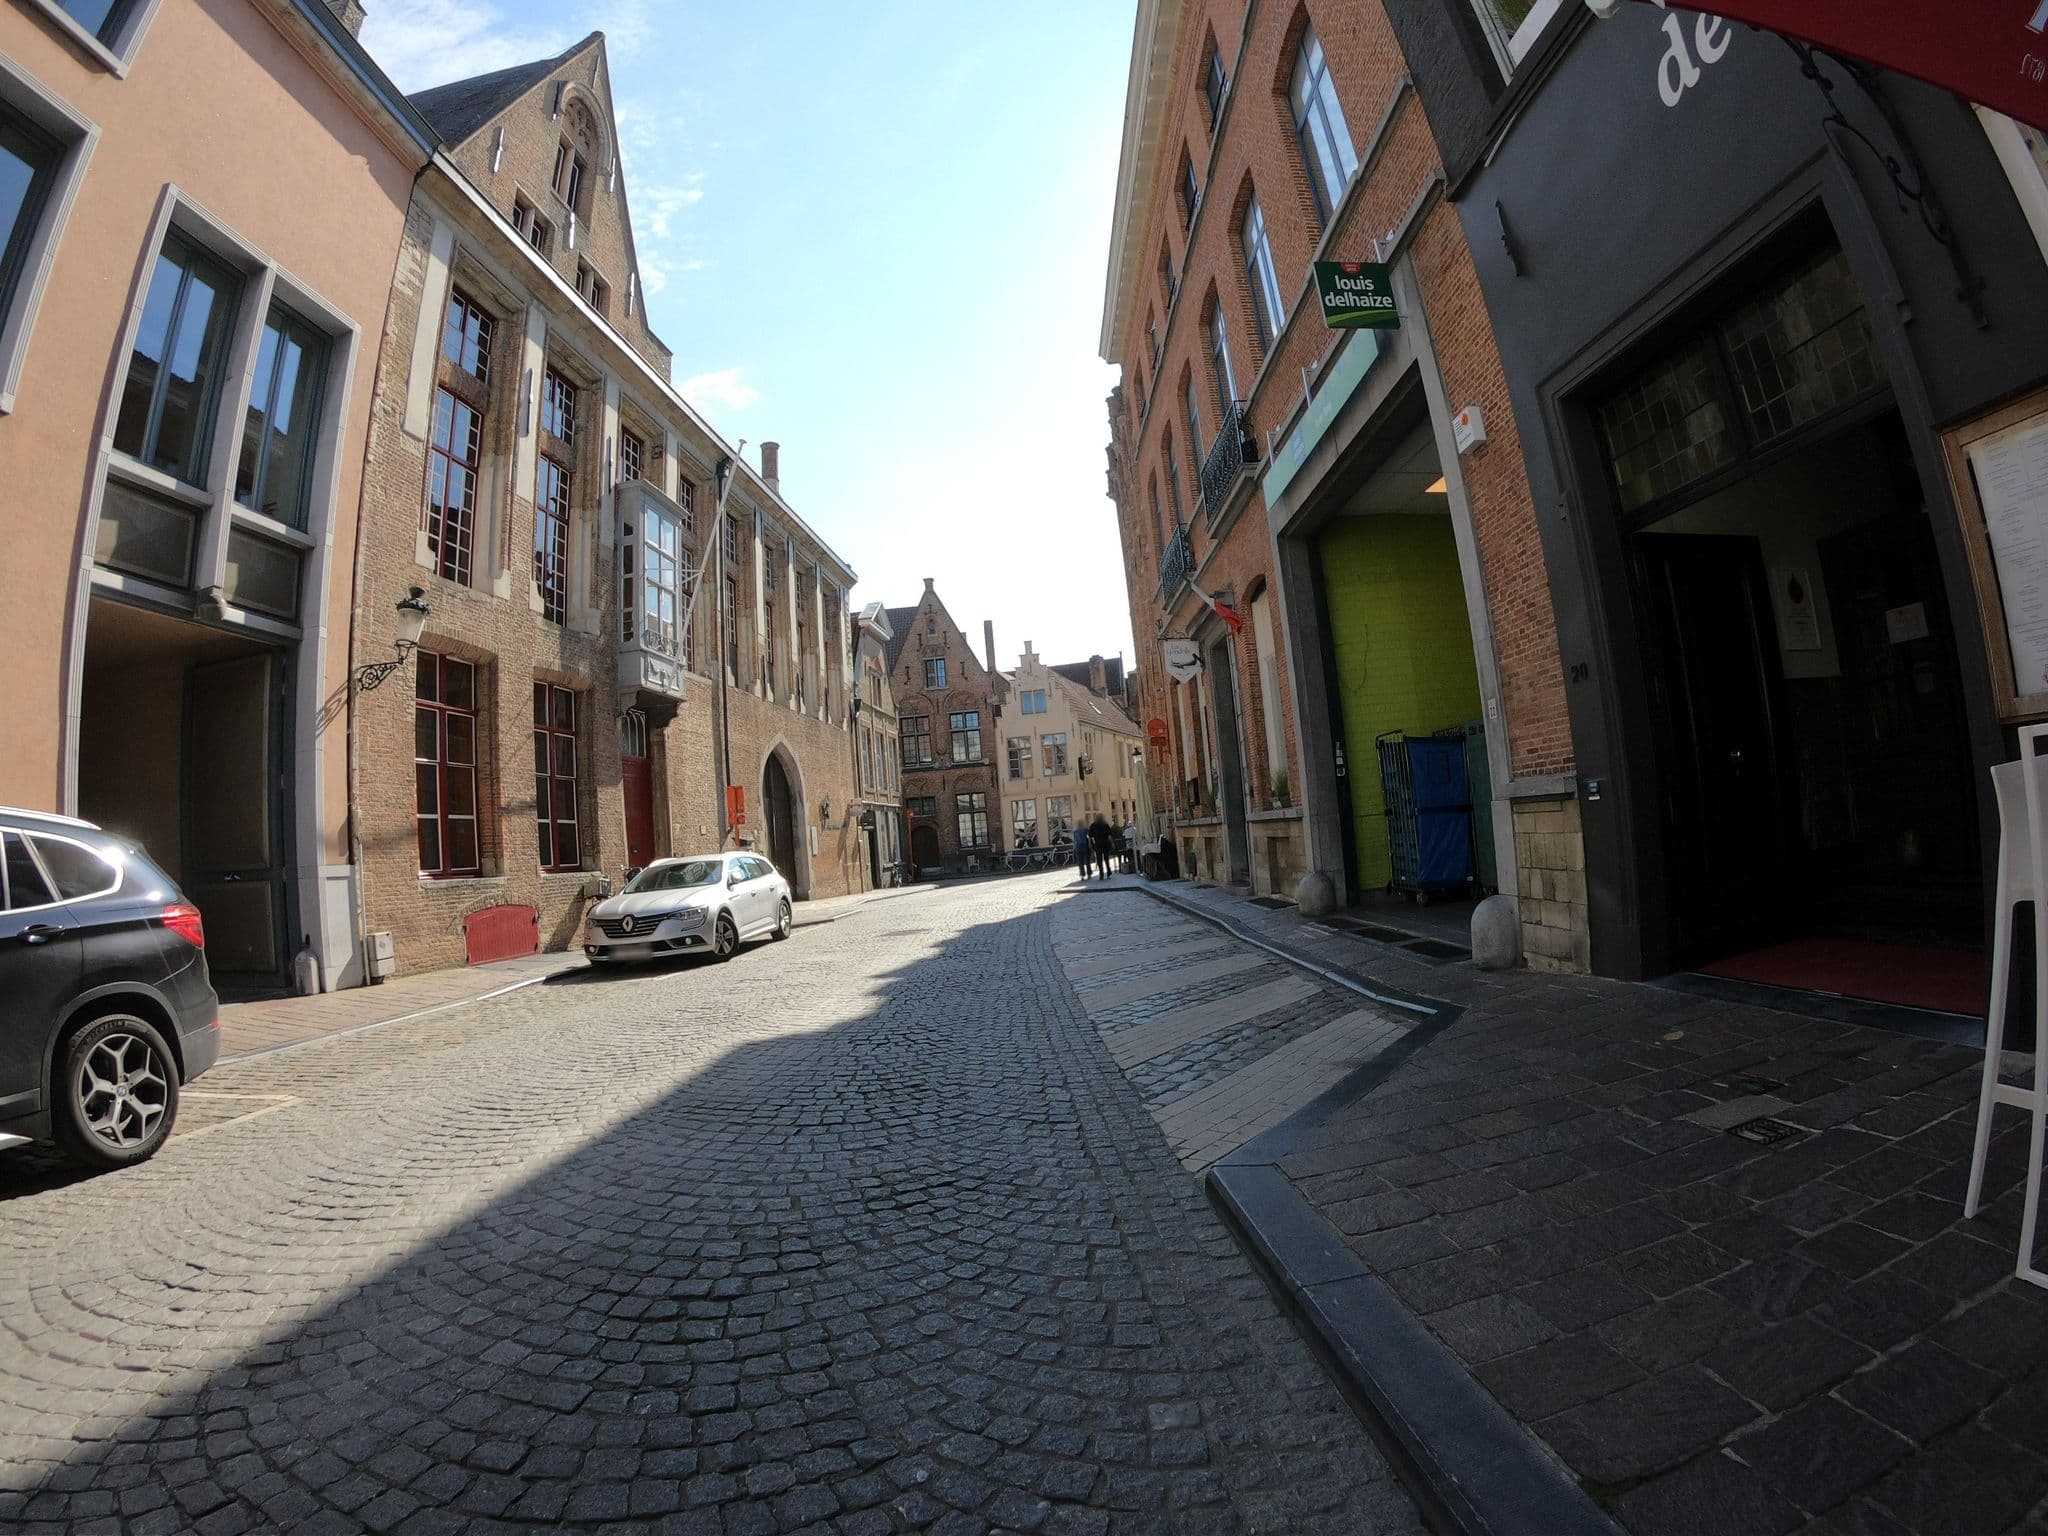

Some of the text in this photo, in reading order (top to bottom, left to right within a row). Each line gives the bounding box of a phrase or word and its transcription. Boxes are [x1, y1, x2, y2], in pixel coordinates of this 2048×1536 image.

[1334, 275, 1375, 290] louis
[1325, 291, 1393, 307] delhaize
[1570, 661, 1588, 684] 20
